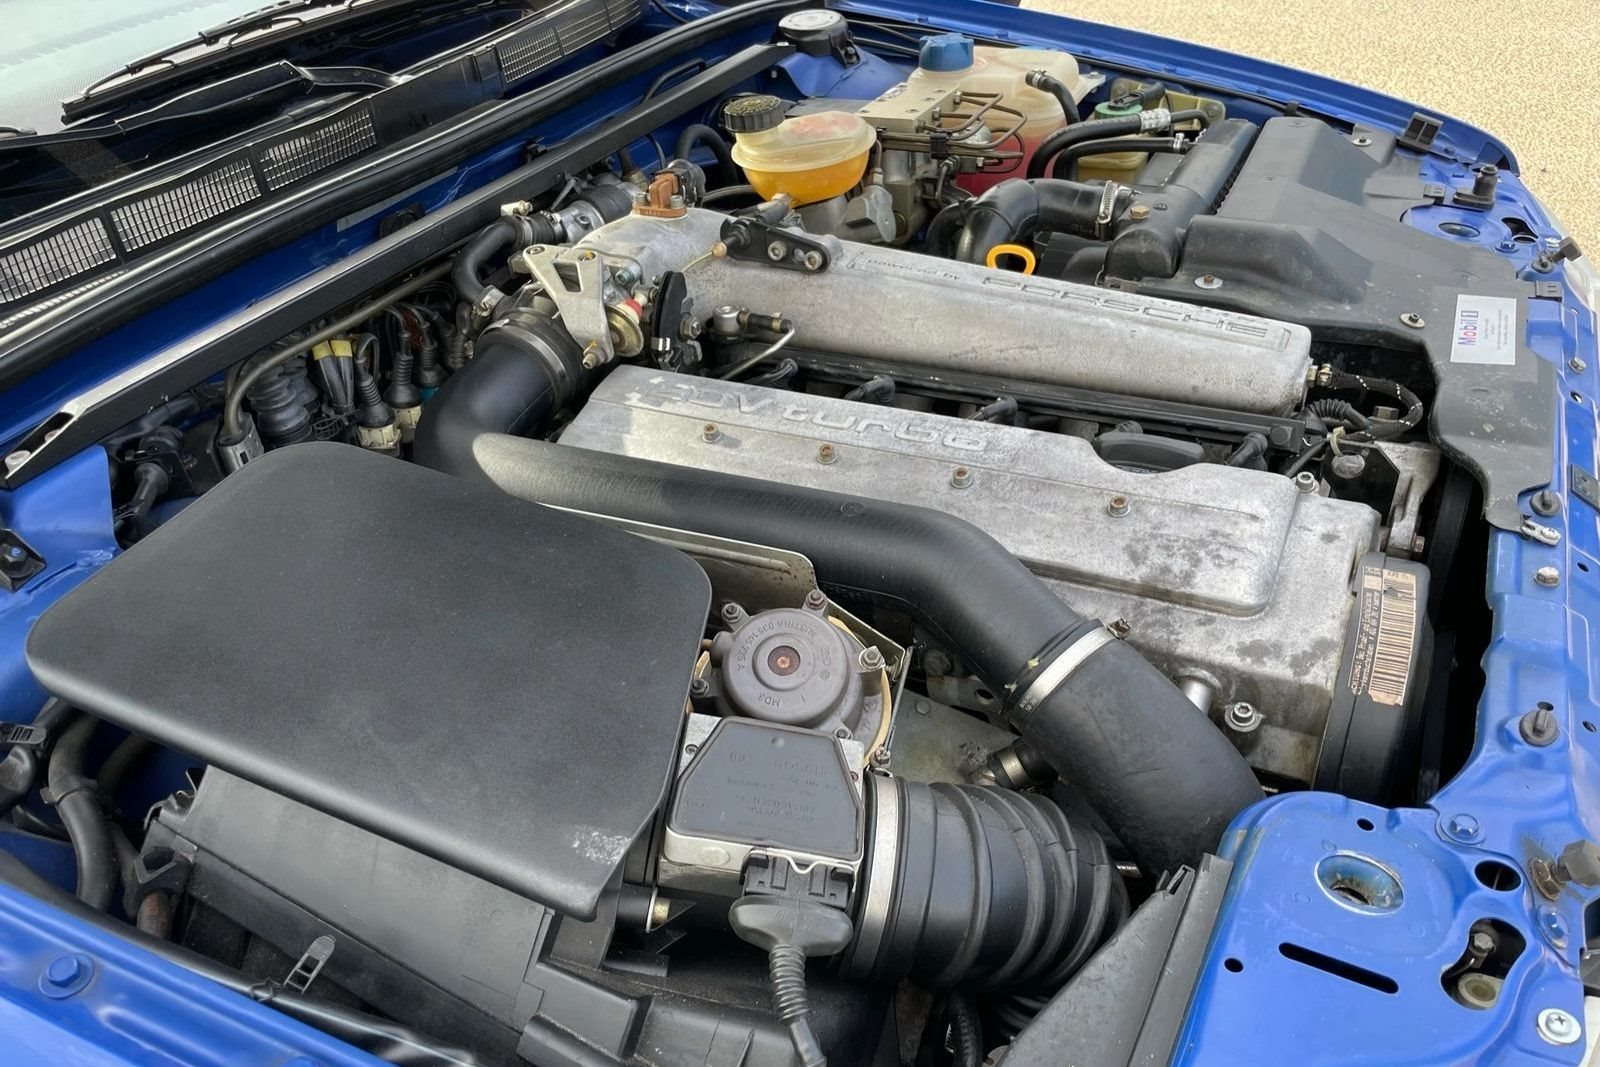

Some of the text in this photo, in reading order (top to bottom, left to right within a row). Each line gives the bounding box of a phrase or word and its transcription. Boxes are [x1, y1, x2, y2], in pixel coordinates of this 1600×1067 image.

[982, 275, 1270, 338] PORSCHE
[1457, 319, 1477, 346] Mobil
[782, 402, 990, 452] turbo
